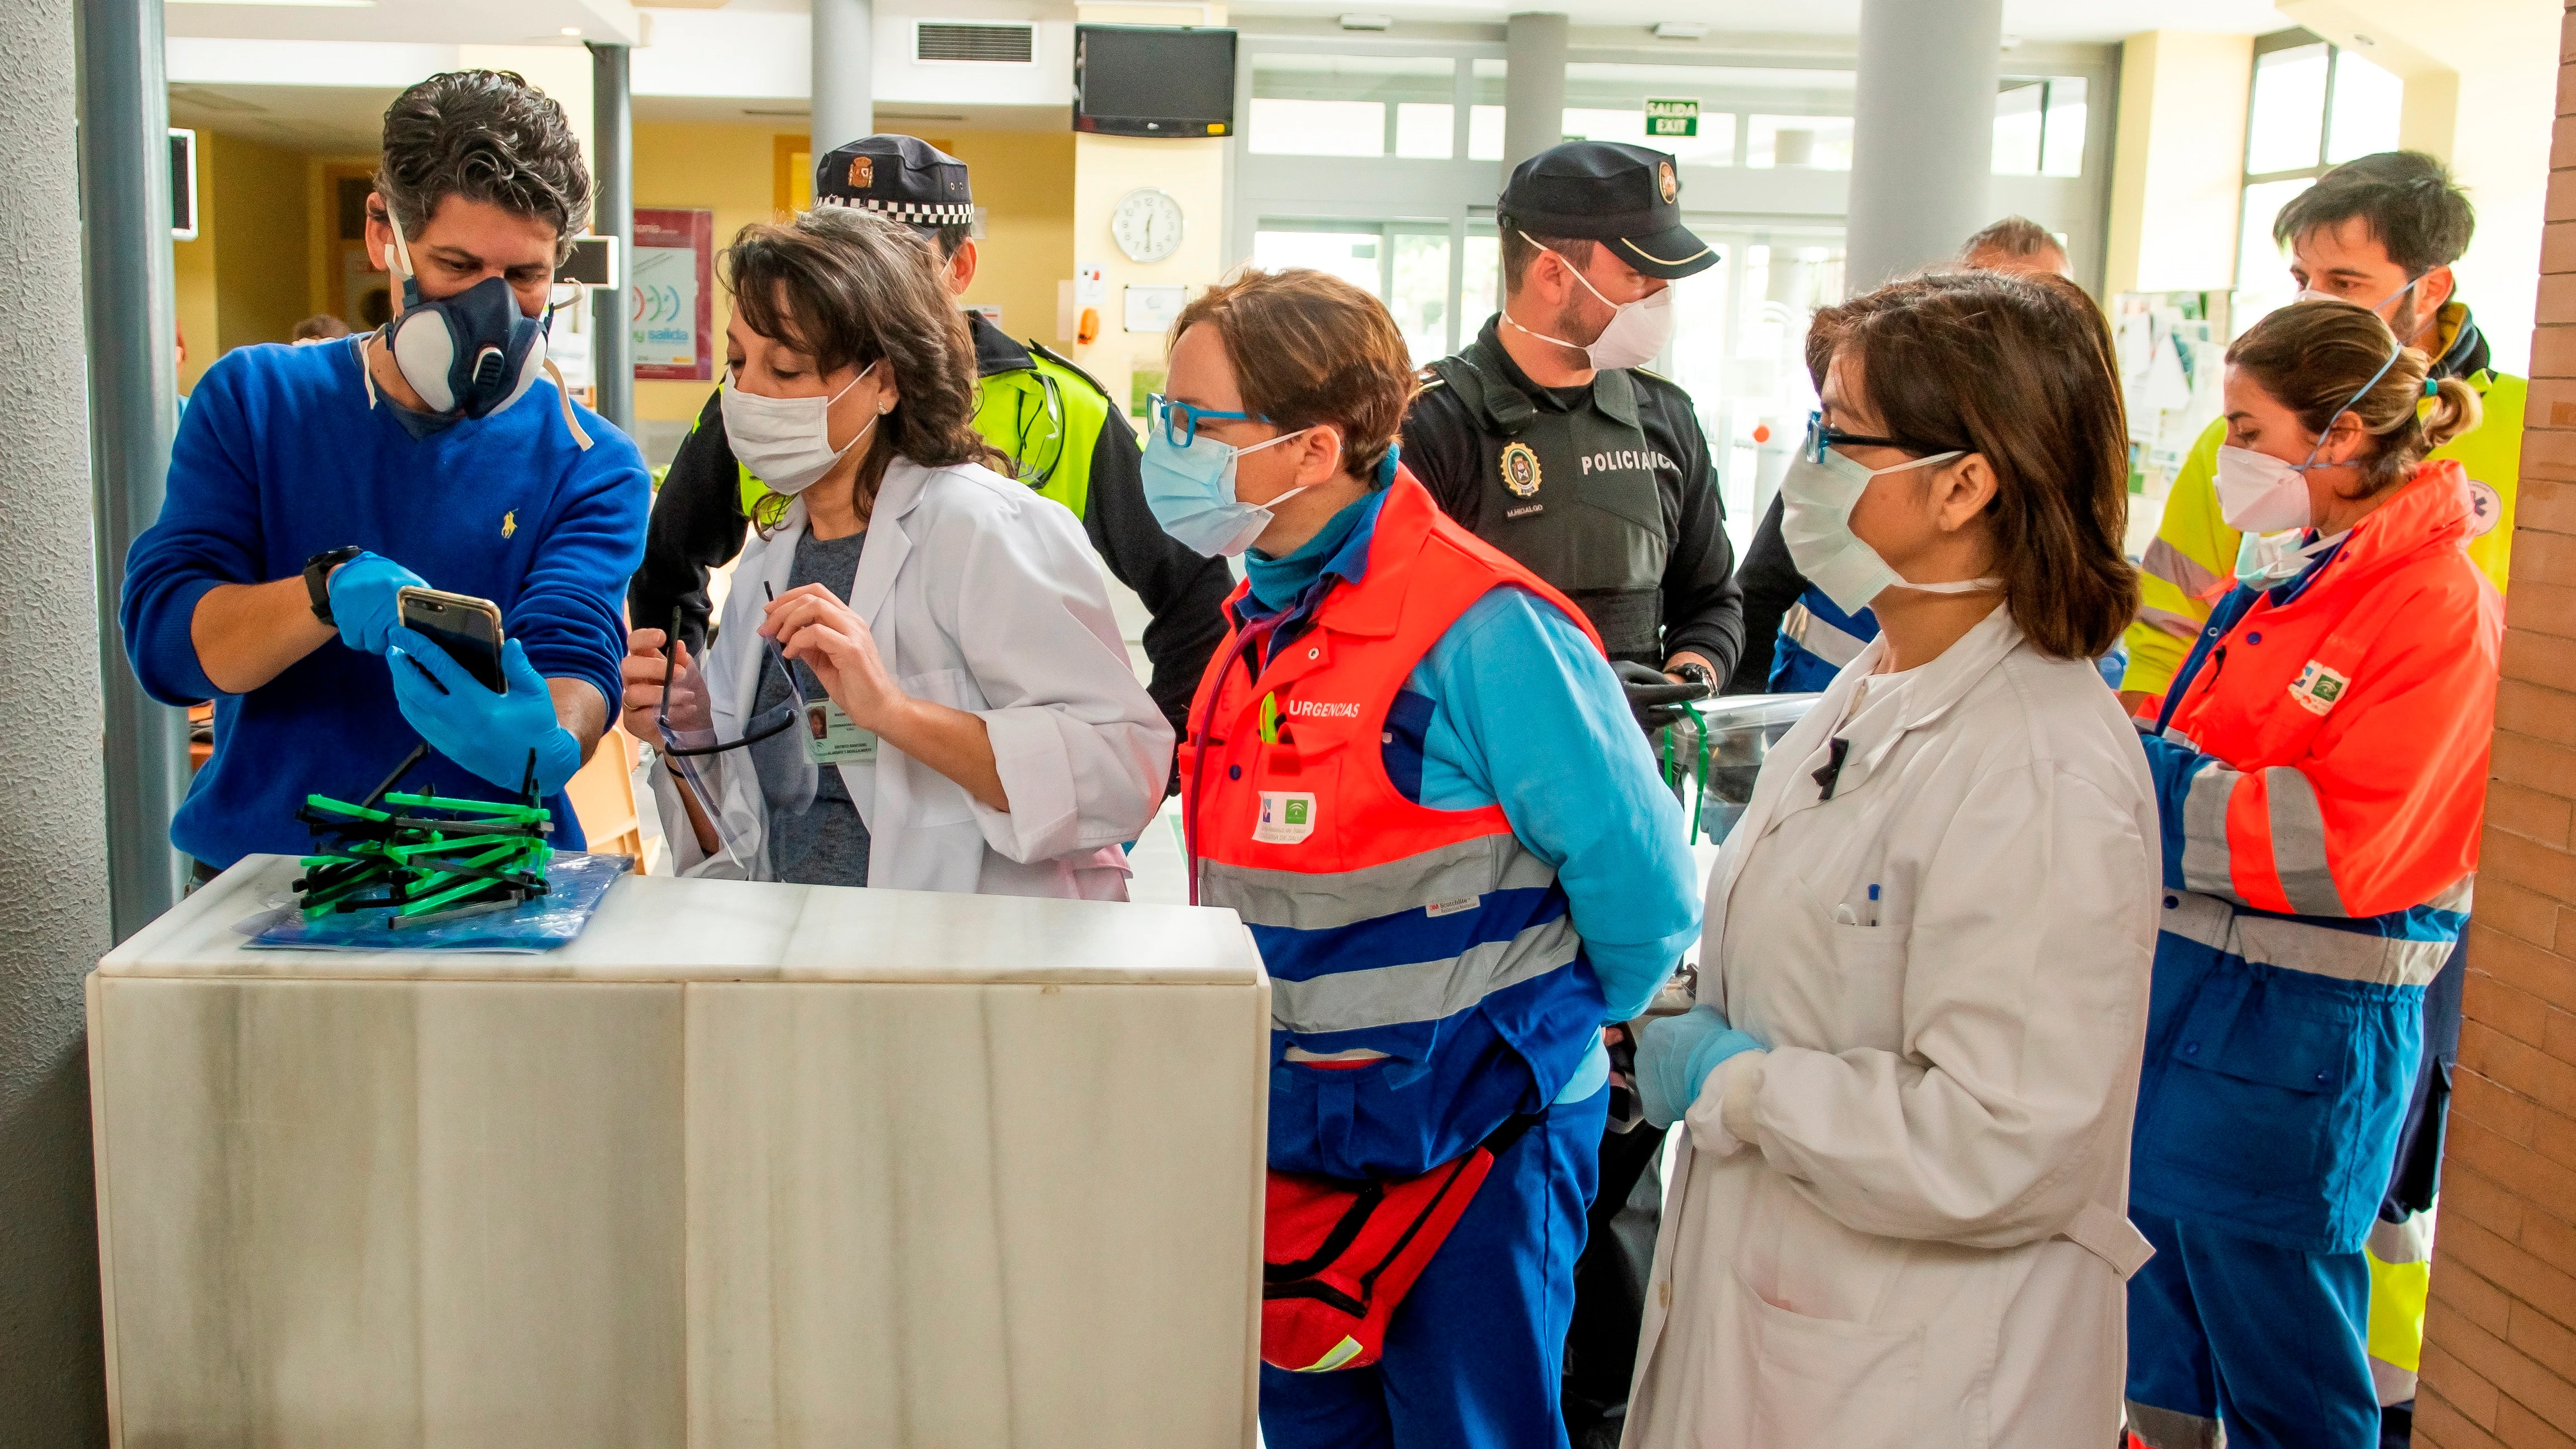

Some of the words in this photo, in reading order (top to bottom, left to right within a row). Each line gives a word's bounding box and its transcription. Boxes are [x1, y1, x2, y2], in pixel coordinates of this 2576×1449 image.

[1648, 102, 1697, 116] SALIDA
[1656, 119, 1687, 132] EXIT
[1144, 198, 1153, 206] 12
[1165, 209, 1172, 218] 2
[1122, 220, 1128, 228] 9
[1168, 222, 1174, 231] 3
[1134, 241, 1140, 250] 7
[1157, 242, 1163, 251] 5
[647, 328, 688, 340] salida
[1582, 450, 1651, 475] POLICIA
[1289, 700, 1360, 717] URGENCIAS
